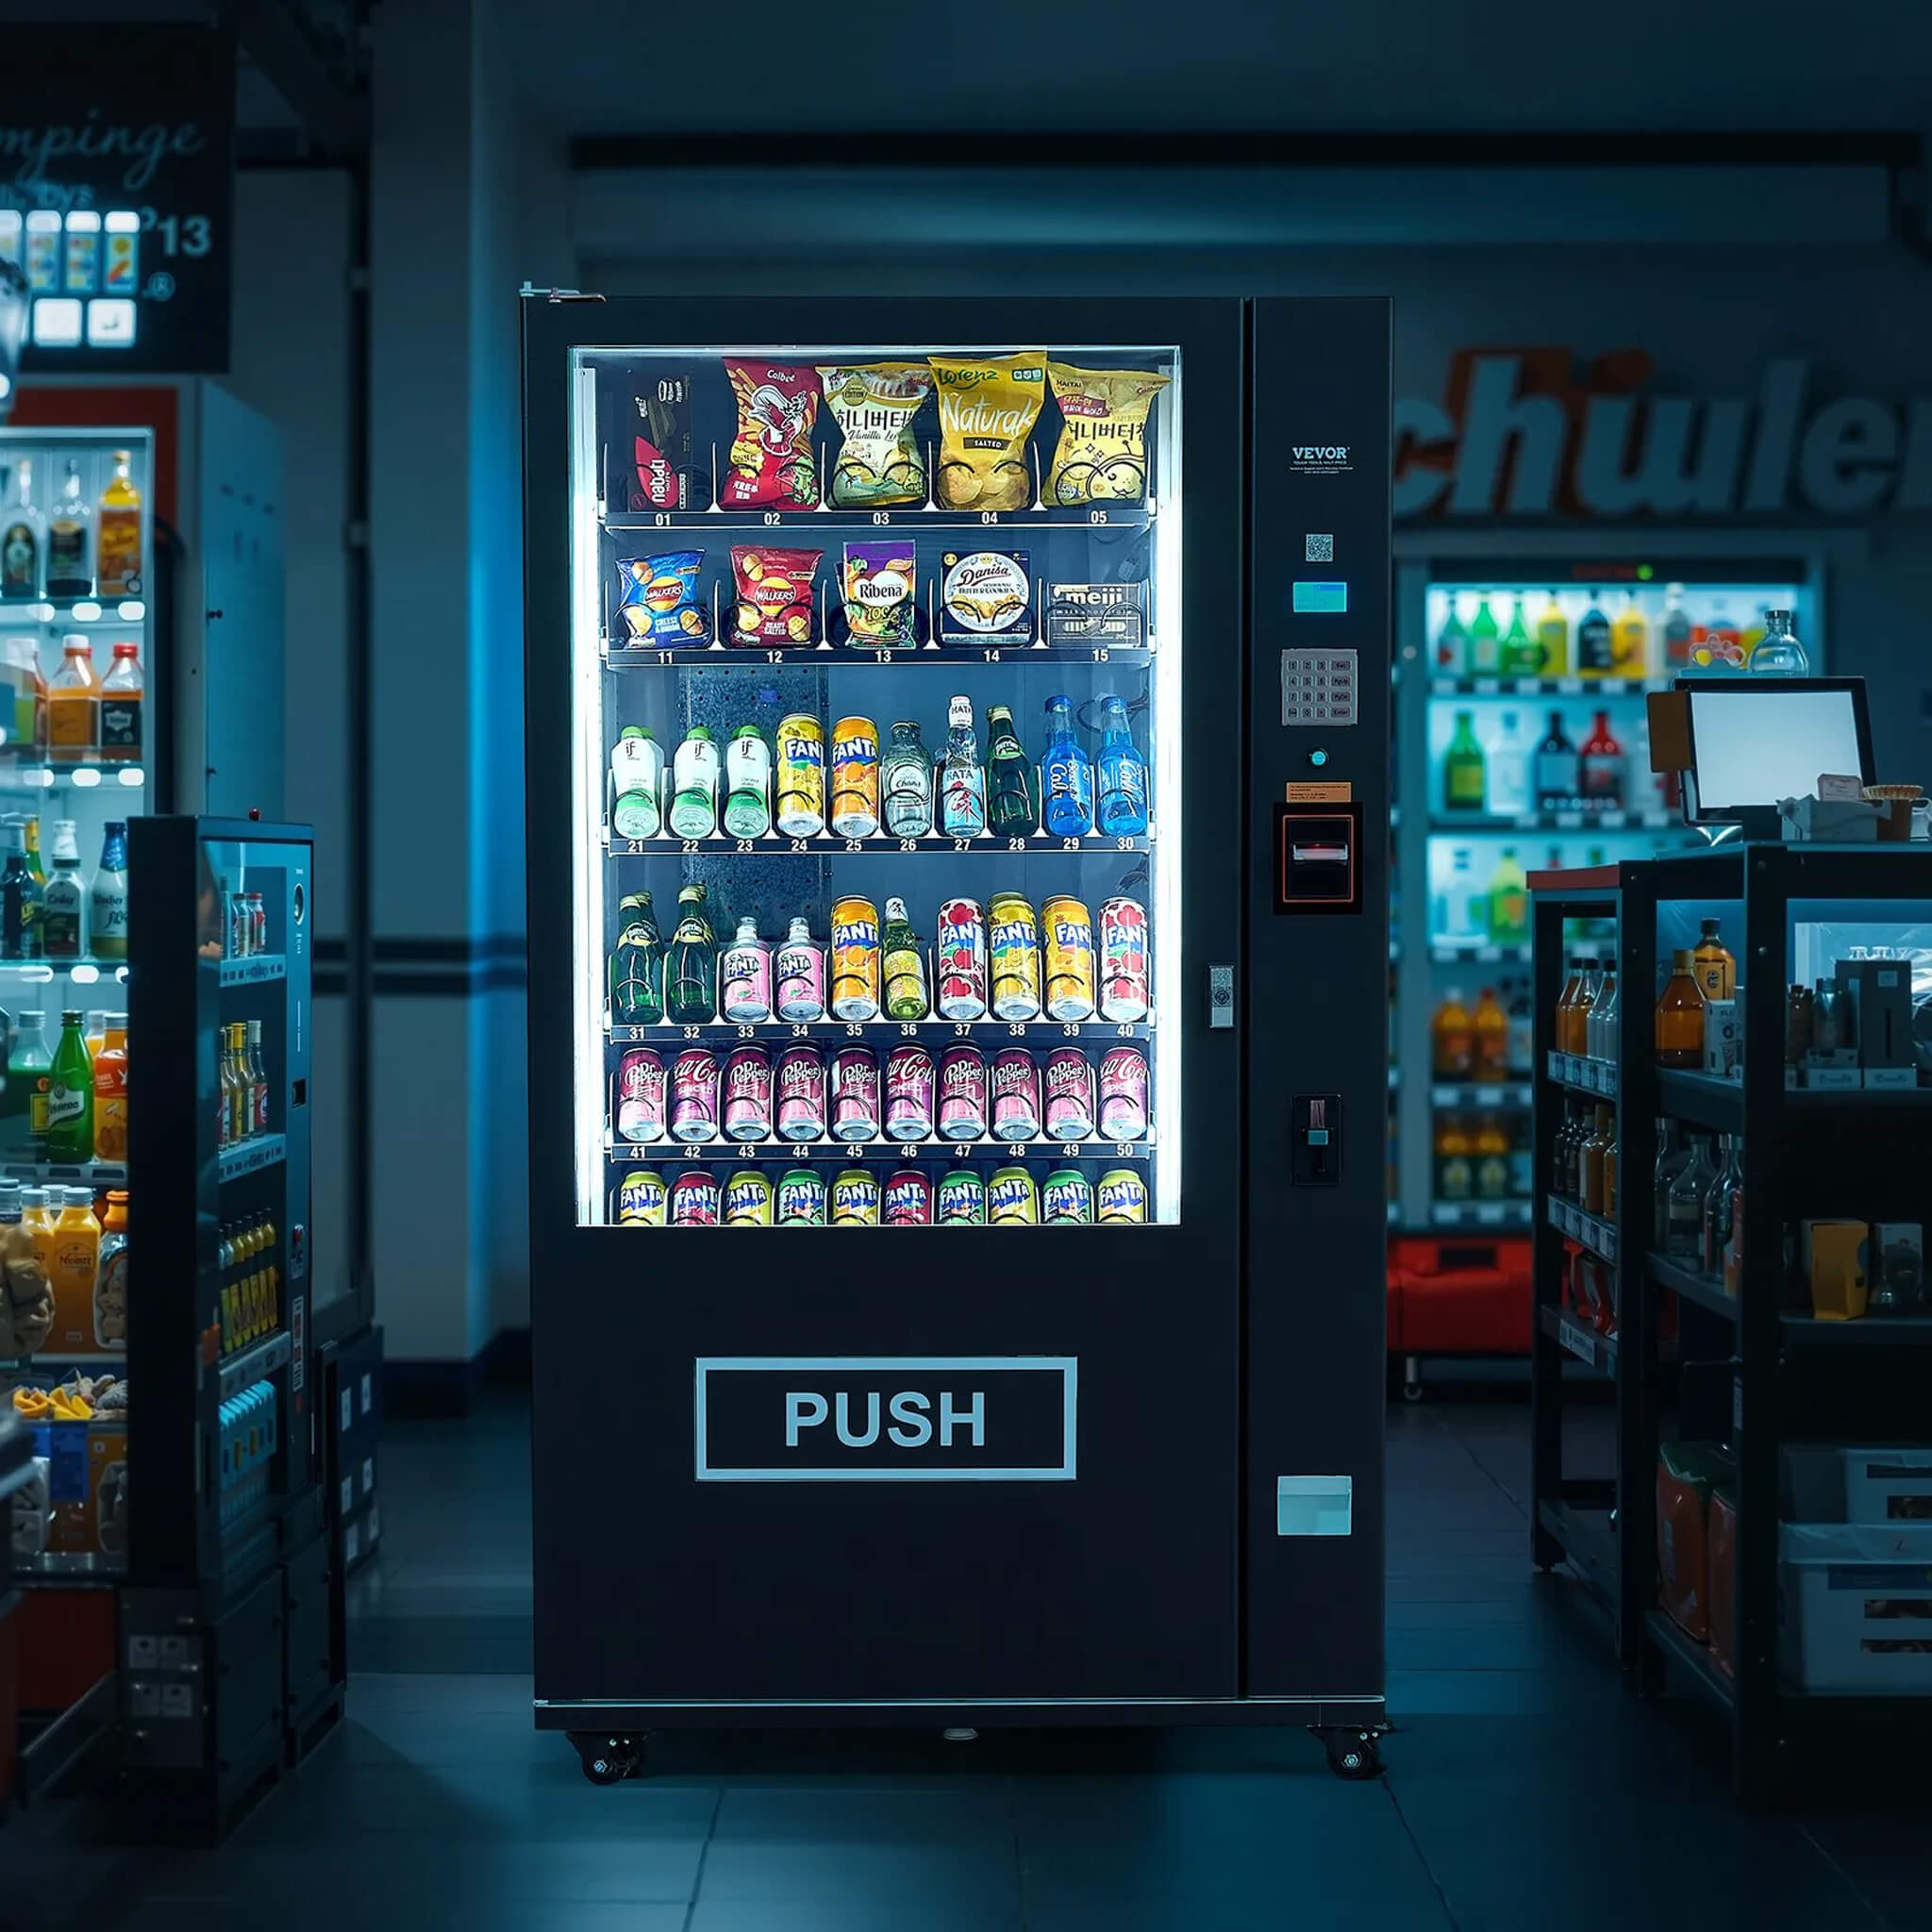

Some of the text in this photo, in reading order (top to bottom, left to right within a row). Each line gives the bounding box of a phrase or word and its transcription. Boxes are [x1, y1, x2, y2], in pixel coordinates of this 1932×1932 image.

[938, 368, 999, 385] Lorenz
[1292, 446, 1347, 459] VEVOR
[655, 512, 671, 526] 01
[764, 512, 781, 525] 02
[873, 512, 890, 525] 03
[981, 511, 998, 525] 04
[1091, 510, 1108, 525] 05
[956, 564, 1009, 587] Danisa
[756, 591, 793, 601] WALKERS
[859, 583, 903, 599] Ribena
[1066, 587, 1123, 608] meiji
[658, 651, 673, 664] 11
[766, 650, 783, 664] 12
[874, 649, 891, 663] 13
[984, 649, 1000, 662] 14
[1092, 649, 1109, 662] 15
[787, 740, 823, 760] FAN
[627, 840, 643, 853] 21
[682, 840, 699, 853] 22
[737, 839, 754, 854] 23
[791, 839, 808, 852] 24
[845, 839, 862, 852] 25
[900, 838, 917, 852] 26
[955, 838, 971, 851] 27
[1008, 837, 1025, 852] 28
[1063, 837, 1080, 850] 29
[1117, 837, 1134, 850] 30
[629, 1025, 644, 1040] 31
[684, 1025, 700, 1040] 32
[738, 1024, 755, 1038] 33
[791, 1024, 808, 1037] 34
[846, 1024, 863, 1037] 35
[900, 1023, 917, 1036] 36
[955, 1023, 972, 1036] 37
[1008, 1023, 1025, 1036] 38
[1063, 1023, 1080, 1037] 39
[1116, 1023, 1134, 1037] 40
[629, 1146, 645, 1159] 41
[684, 1145, 701, 1158] 42
[738, 1145, 756, 1158] 43
[792, 1145, 809, 1158] 44
[846, 1144, 863, 1158] 45
[901, 1144, 918, 1158] 46
[955, 1144, 972, 1158] 47
[1008, 1143, 1025, 1157] 48
[1062, 1143, 1079, 1157] 49
[1116, 1142, 1134, 1157] 50
[785, 1391, 984, 1447] PUSH
